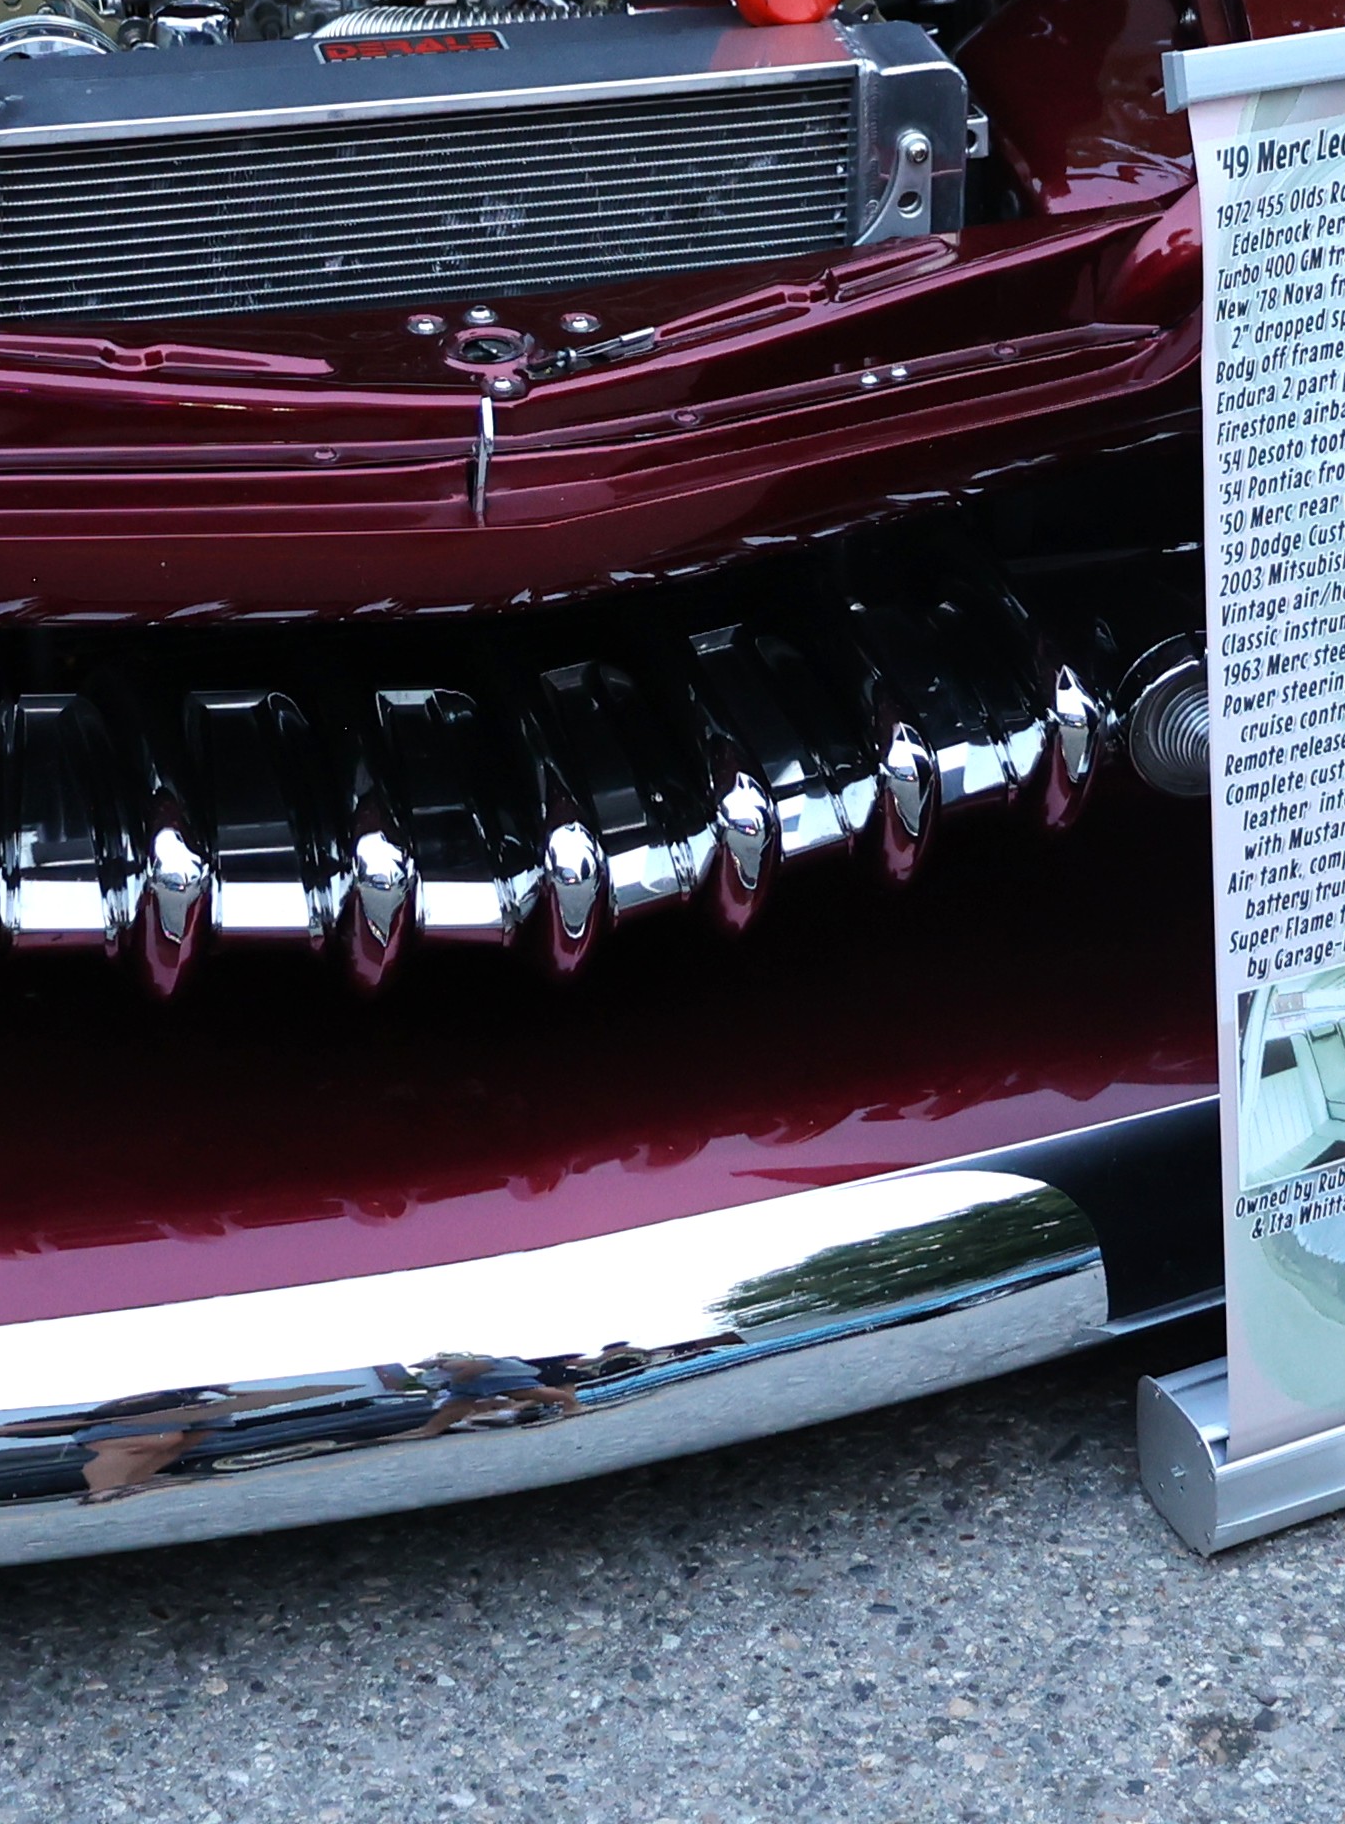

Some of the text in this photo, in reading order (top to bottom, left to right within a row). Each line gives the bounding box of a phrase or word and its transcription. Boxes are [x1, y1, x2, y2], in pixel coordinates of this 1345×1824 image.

[324, 33, 499, 60] DERALE
[1216, 144, 1253, 180] '49
[1255, 138, 1312, 174] Merc
[1216, 199, 1255, 229] 1972
[1256, 192, 1288, 220] 455
[1289, 185, 1327, 212] Olds
[1231, 217, 1314, 257] Edelbrock
[1216, 262, 1263, 292] Turbo
[1264, 251, 1298, 279] 400
[1299, 245, 1327, 272] GM
[1215, 297, 1252, 322] New
[1255, 286, 1281, 313] '78
[1281, 281, 1326, 306] Nova
[1254, 307, 1329, 344] dropped
[1215, 355, 1259, 385] Body
[1260, 344, 1291, 374] off
[1215, 384, 1278, 415] Endura
[1281, 375, 1295, 400] 2
[1295, 368, 1338, 401] part
[1216, 410, 1299, 446] Firestone
[1218, 448, 1244, 475] '54
[1246, 438, 1307, 469] Desoto
[1218, 478, 1244, 505] '54
[1247, 466, 1315, 500] Pontiac
[1219, 508, 1247, 535] '50
[1249, 502, 1296, 529] Merc
[1298, 493, 1343, 519] rear
[1219, 540, 1247, 566] '59
[1249, 531, 1305, 560] Dodge
[1218, 565, 1265, 597] 2003
[1221, 595, 1289, 627] Vintage
[1221, 624, 1278, 657] Classic
[1222, 656, 1264, 687] 1963
[1265, 651, 1311, 677] Merc
[1222, 688, 1279, 718] Power
[1240, 712, 1297, 743] cruise
[1223, 744, 1287, 777] Remote
[1224, 770, 1307, 806] Complete
[1242, 799, 1311, 831] leather
[1244, 832, 1286, 861] with
[1226, 869, 1257, 895] Air
[1244, 888, 1313, 920] battery
[1228, 924, 1282, 953] Super
[1284, 910, 1337, 940] Flame
[1246, 955, 1271, 980] by
[1235, 1183, 1288, 1218] Owned
[1292, 1180, 1316, 1203] by
[1251, 1217, 1263, 1239] &
[1268, 1212, 1293, 1235] Ita
